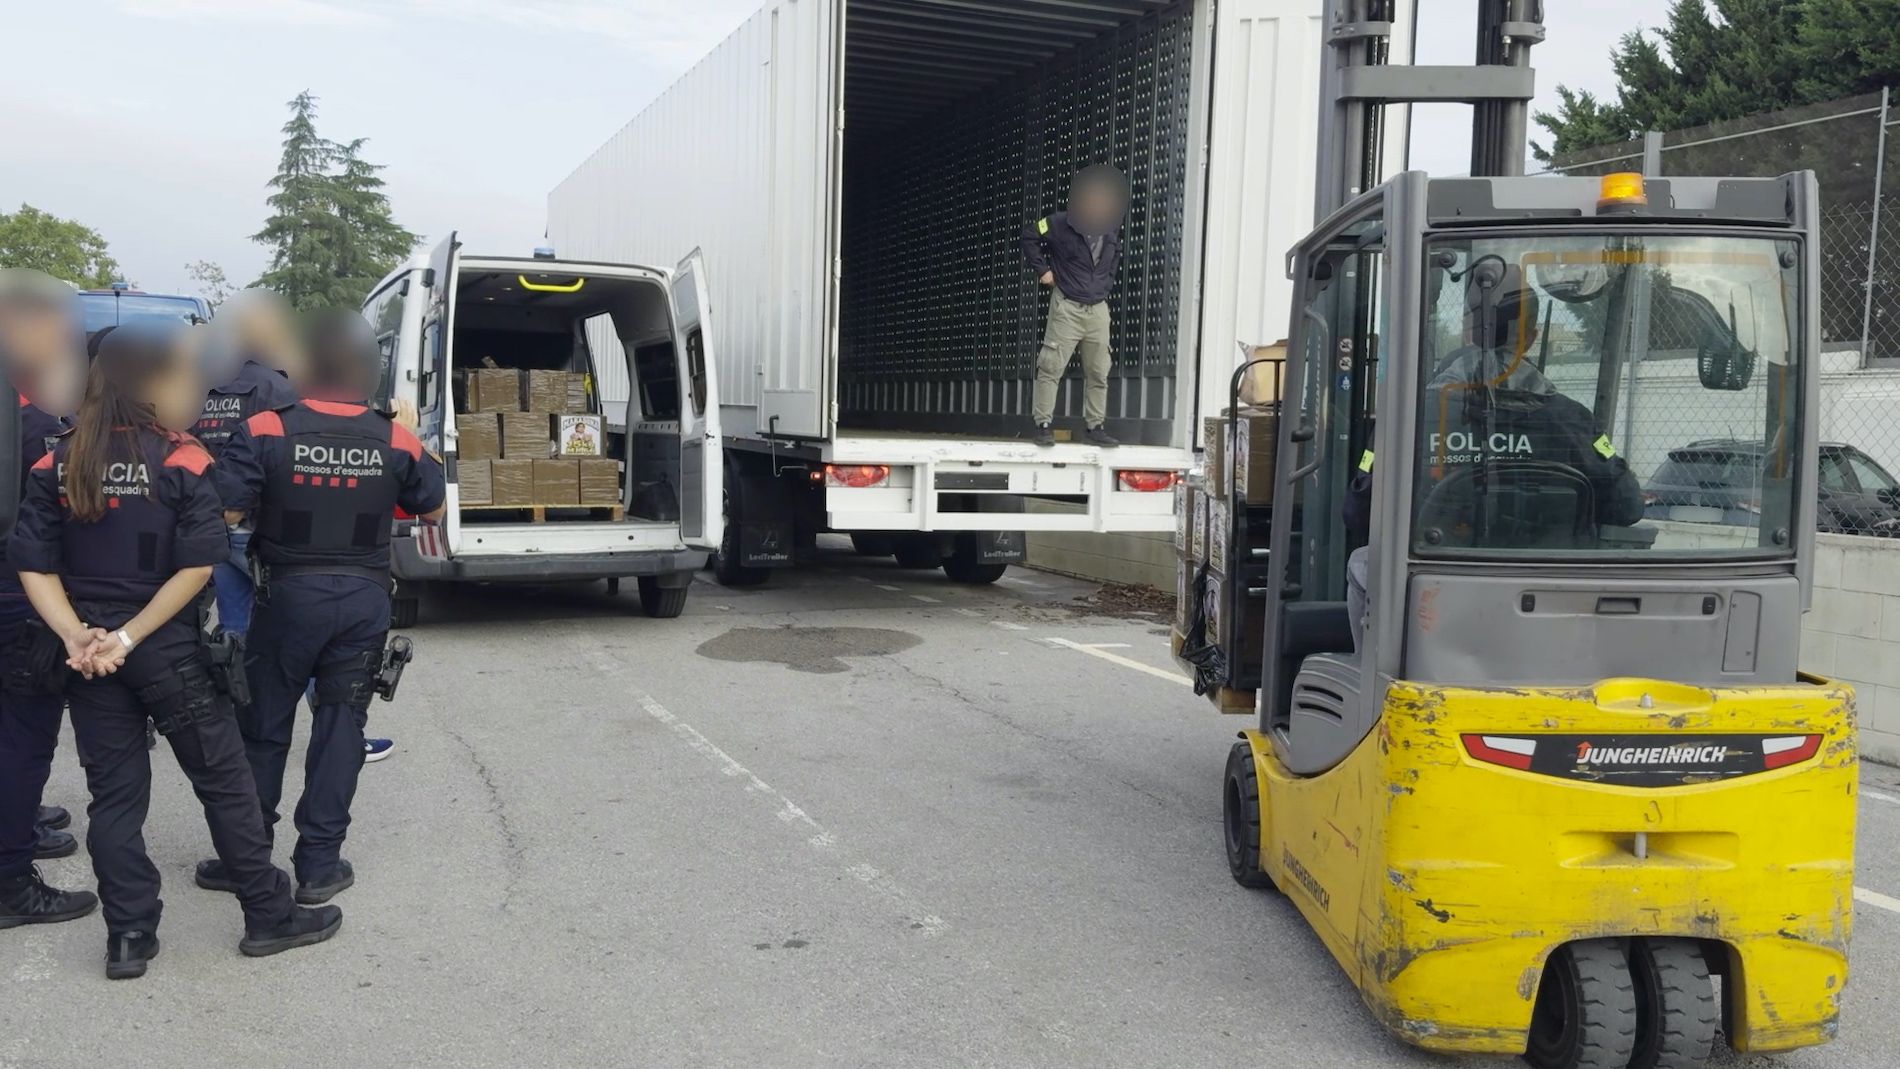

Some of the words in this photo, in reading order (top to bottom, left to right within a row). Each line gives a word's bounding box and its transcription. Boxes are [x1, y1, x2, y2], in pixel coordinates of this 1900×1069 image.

[205, 398, 240, 411] OLICIA
[295, 444, 384, 466] POLICIA
[294, 464, 331, 475] mossos
[333, 465, 382, 478] d'esquadra
[1576, 743, 1727, 765] JUNGHEINRICH
